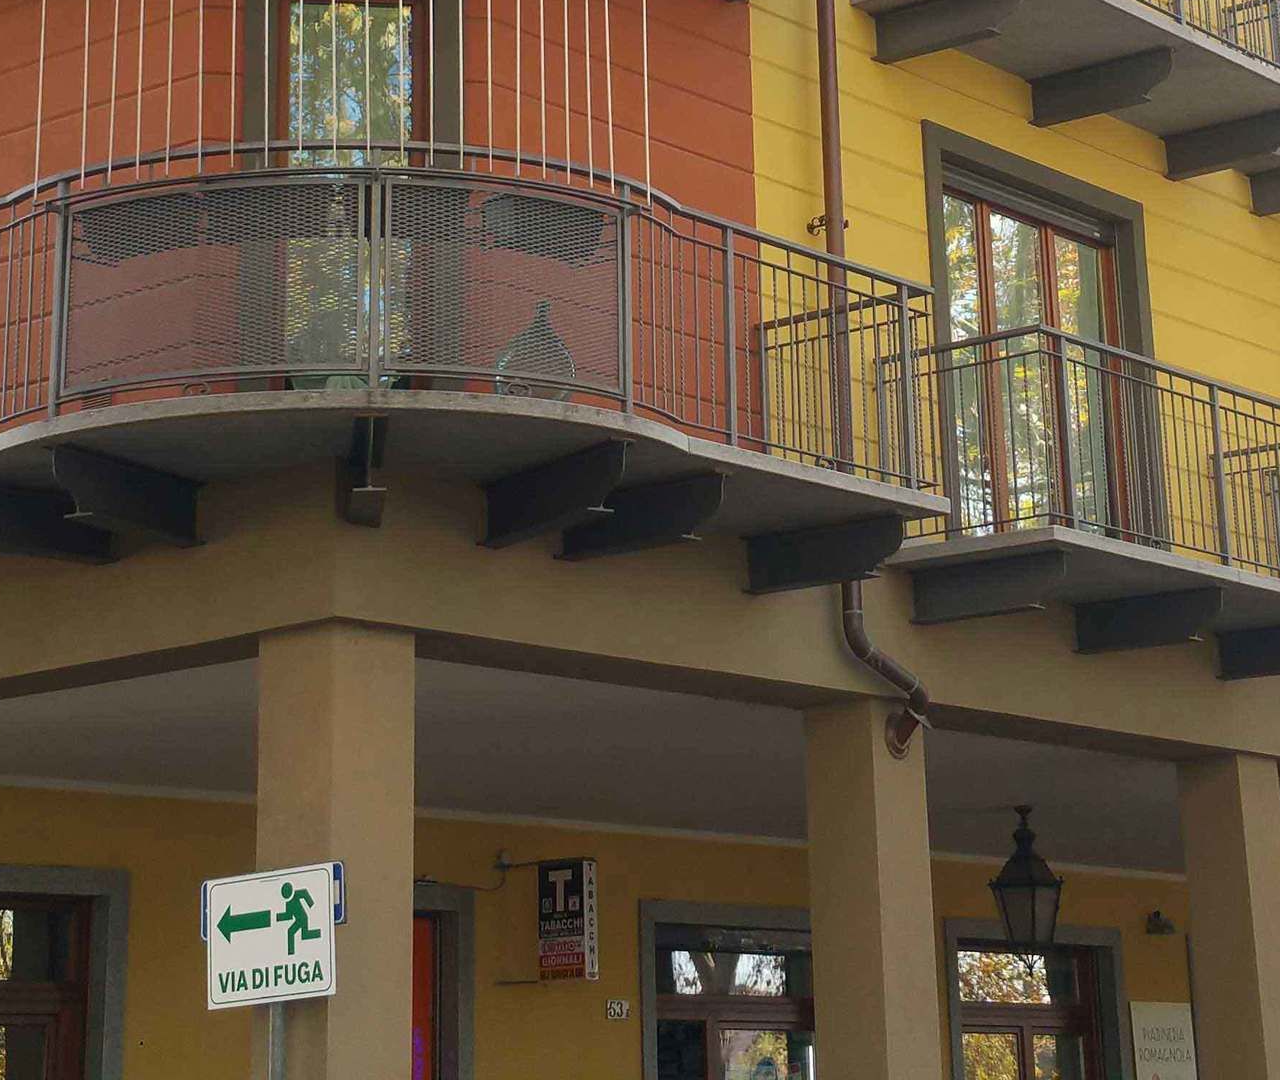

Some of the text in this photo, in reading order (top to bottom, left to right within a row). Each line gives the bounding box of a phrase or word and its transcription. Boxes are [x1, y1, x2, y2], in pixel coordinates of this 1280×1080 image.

[548, 869, 572, 912] T
[540, 916, 584, 932] TABACCHI
[587, 863, 596, 968] TABACCHI
[218, 960, 324, 994] VIA DI FUGA
[608, 1000, 623, 1018] 53
[1138, 1048, 1192, 1063] ROMAGNOLA
